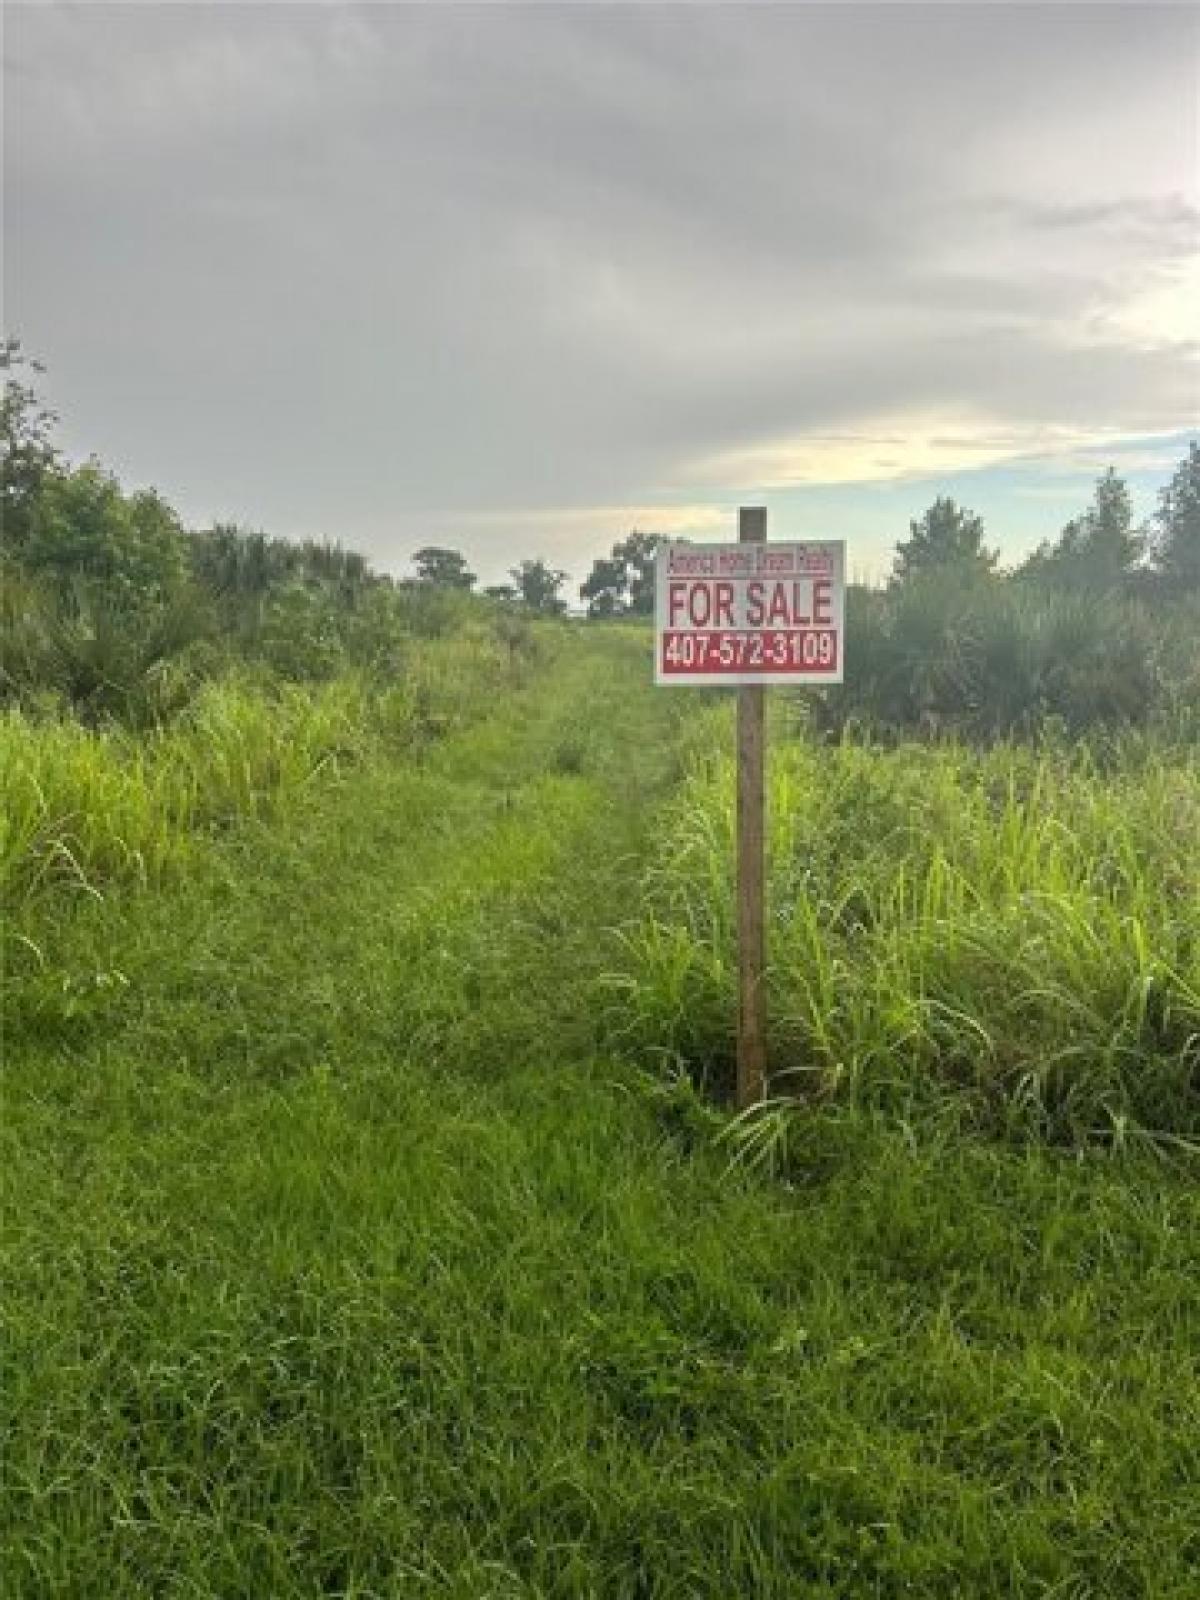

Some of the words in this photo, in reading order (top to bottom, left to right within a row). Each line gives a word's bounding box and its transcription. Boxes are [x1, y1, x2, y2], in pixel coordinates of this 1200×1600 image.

[669, 583, 736, 627] FOR
[746, 580, 832, 627] SALE
[666, 632, 833, 668] 407-572-3109
